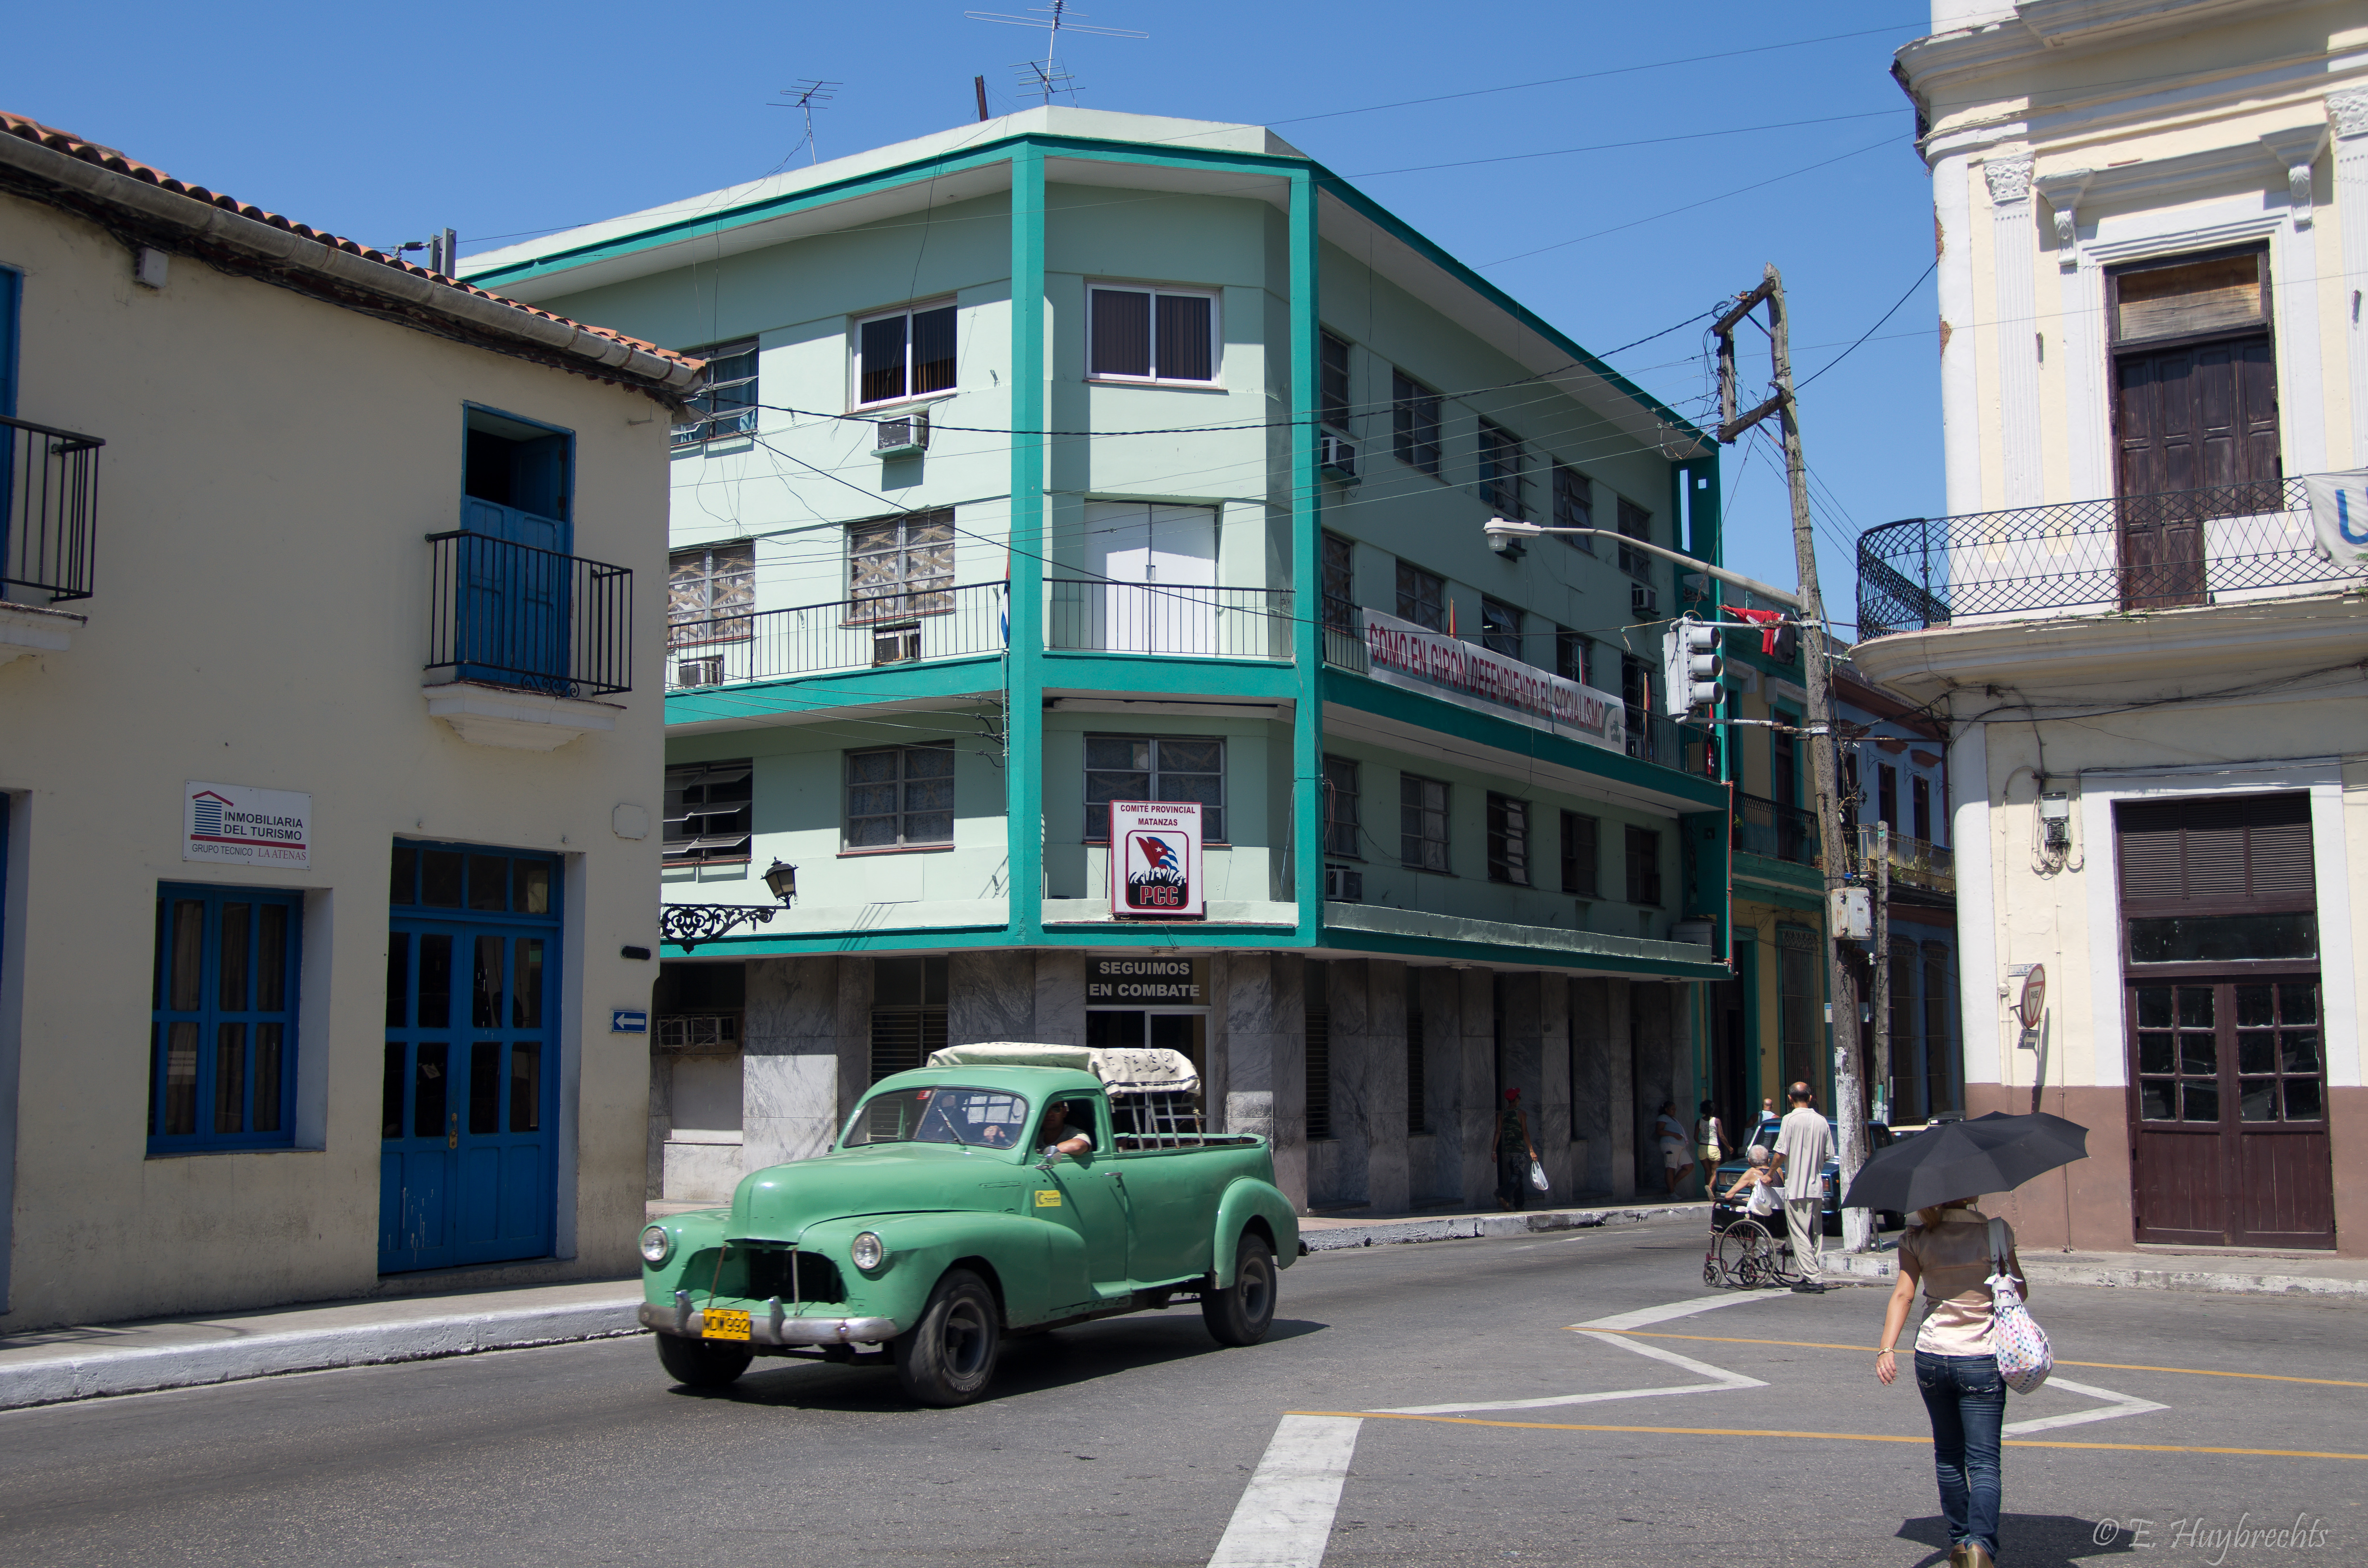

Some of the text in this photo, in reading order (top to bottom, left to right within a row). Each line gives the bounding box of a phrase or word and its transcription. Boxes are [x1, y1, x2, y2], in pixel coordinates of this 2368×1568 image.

[1370, 623, 1603, 733] COMO EN GIRÓN DEFENDIENDO EL SOCIALISMO
[1121, 804, 1196, 814] COMITÉ PROVINCIAL
[224, 811, 303, 828] INMOBILIARIA
[1138, 818, 1178, 826] MATANZAS
[224, 824, 302, 840] DEL TURISMO
[192, 844, 306, 860] GRUPO TECNICO LA ATENAS
[1140, 886, 1178, 905] PCC
[1099, 962, 1190, 975] SEGUIMOS
[1089, 984, 1200, 997] EN COMBATE
